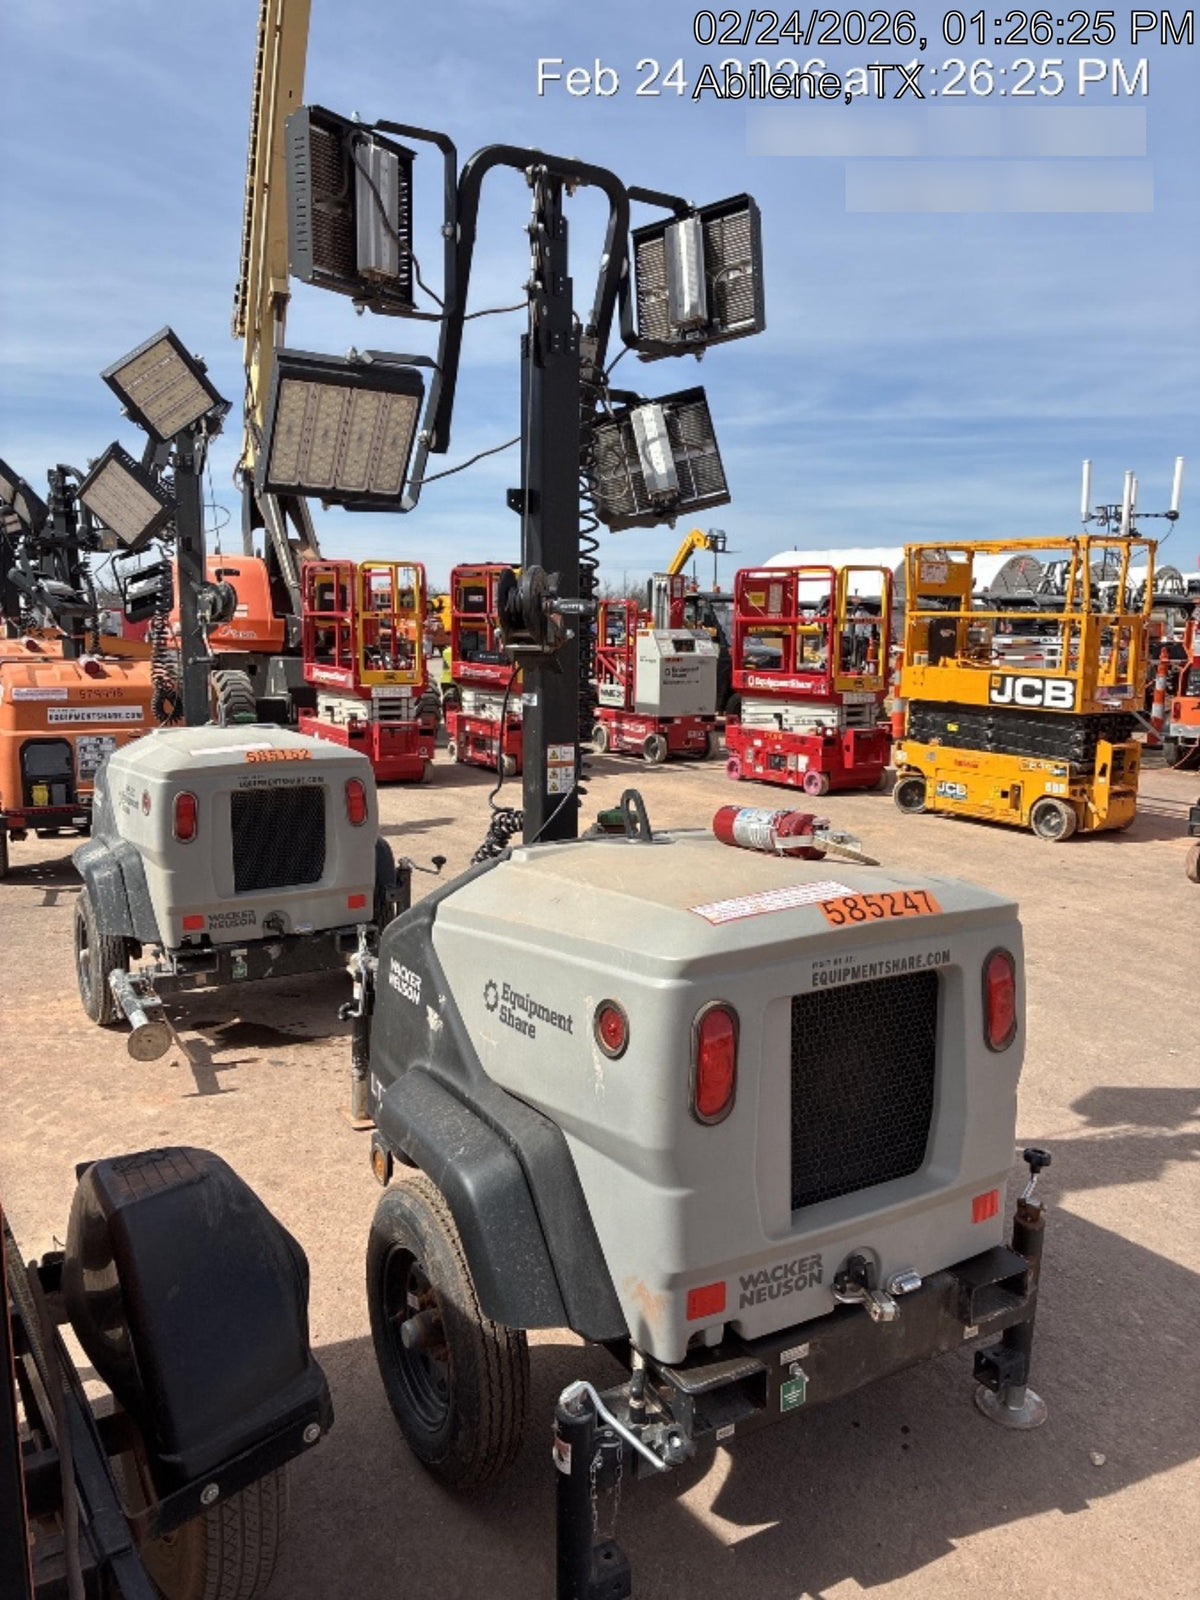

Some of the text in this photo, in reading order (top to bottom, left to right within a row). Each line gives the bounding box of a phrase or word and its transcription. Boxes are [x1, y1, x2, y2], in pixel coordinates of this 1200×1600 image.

[990, 676, 1075, 709] JCB
[936, 782, 967, 796] JCB
[822, 890, 934, 926] 585247
[391, 956, 422, 991] WACKER
[812, 950, 951, 988] EQUIPMENTSHARE.COM
[499, 1004, 536, 1039] Share
[502, 982, 574, 1036] Equipment
[738, 1253, 823, 1291] WACKER
[738, 1269, 823, 1310] NEUSON
